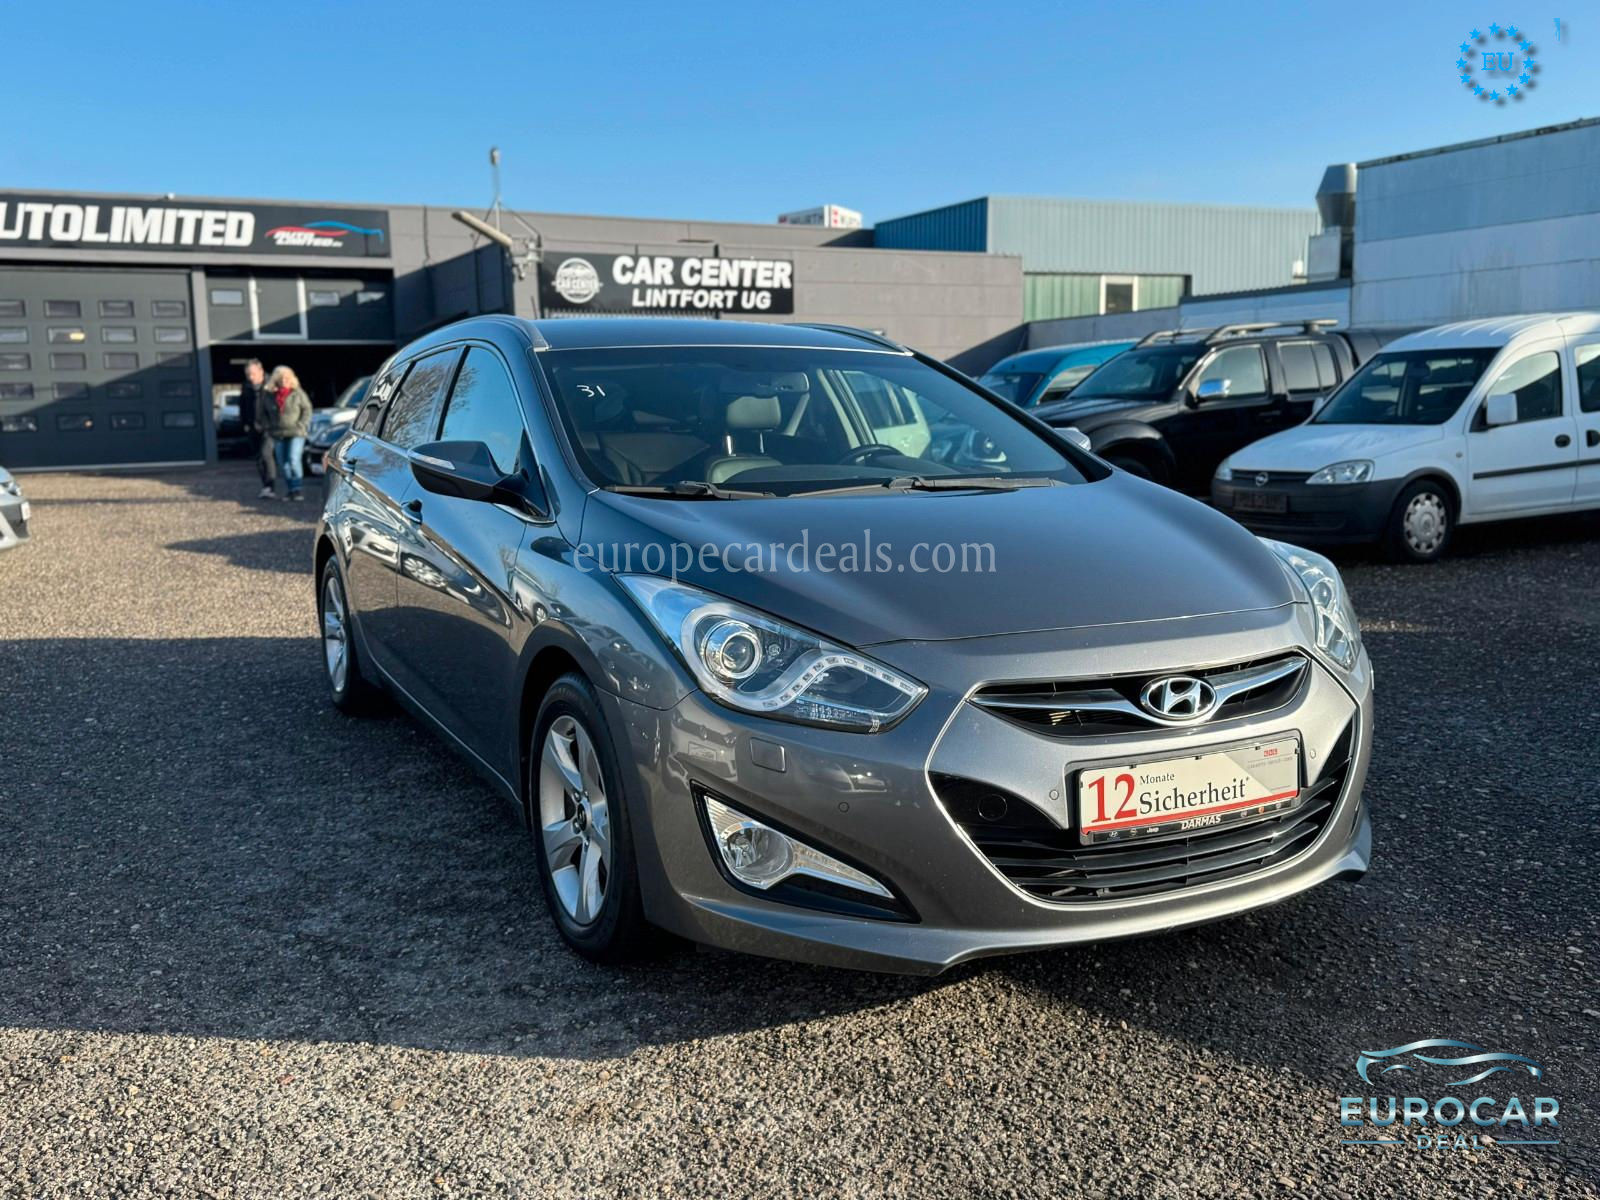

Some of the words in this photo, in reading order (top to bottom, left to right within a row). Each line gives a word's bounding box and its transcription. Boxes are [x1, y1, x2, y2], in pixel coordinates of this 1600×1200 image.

[612, 255, 675, 286] CAR
[680, 257, 793, 289] CENTER
[632, 288, 738, 309] LINTFORT
[741, 290, 772, 309] UG
[576, 385, 606, 398] 31
[1139, 773, 1176, 785] Monate
[1088, 773, 1138, 823] 12
[1180, 815, 1222, 830] DARMAS
